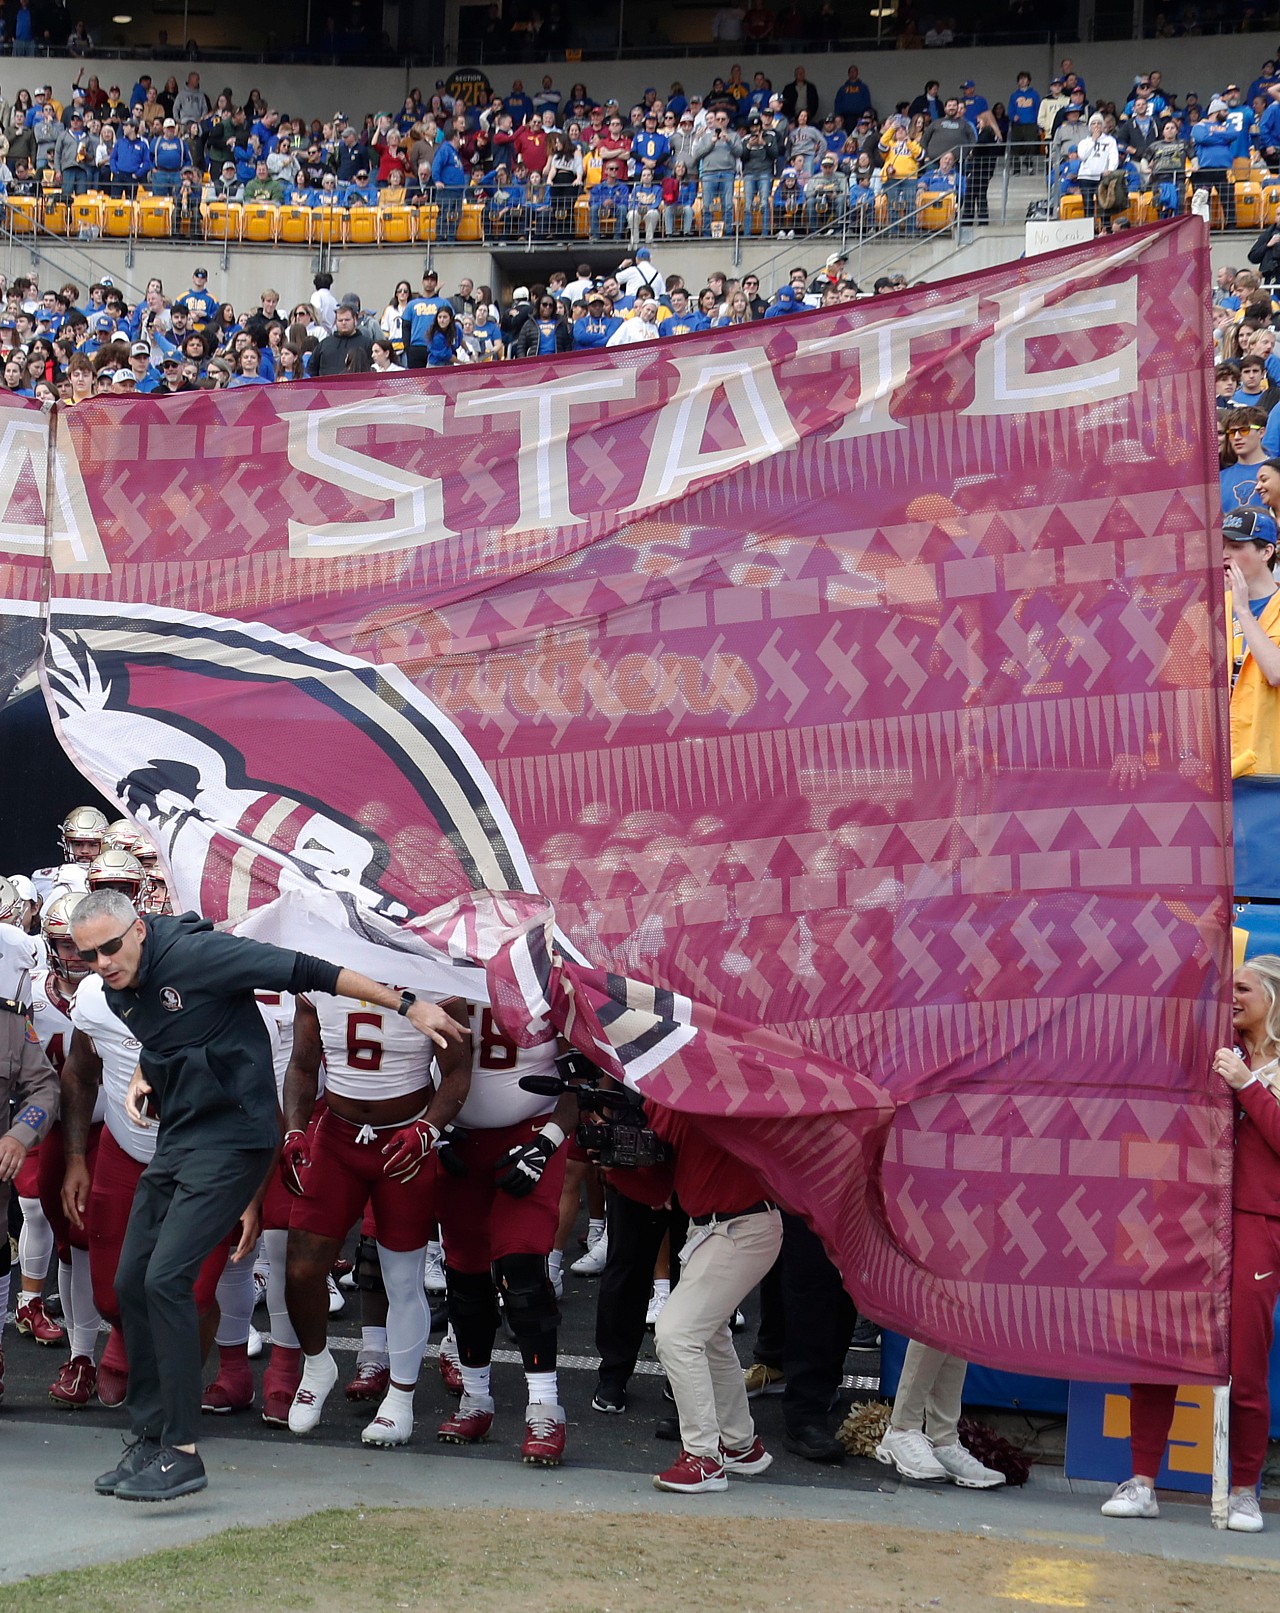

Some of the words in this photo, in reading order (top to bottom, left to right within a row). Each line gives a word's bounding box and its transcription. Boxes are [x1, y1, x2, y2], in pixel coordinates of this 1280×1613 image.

[455, 74, 482, 82] SECTION
[1229, 112, 1243, 132] 3
[1035, 230, 1049, 245] No
[414, 303, 438, 316] Pitt
[277, 268, 1140, 558] STATE
[124, 1040, 140, 1048] ACC
[344, 1011, 385, 1071] 6
